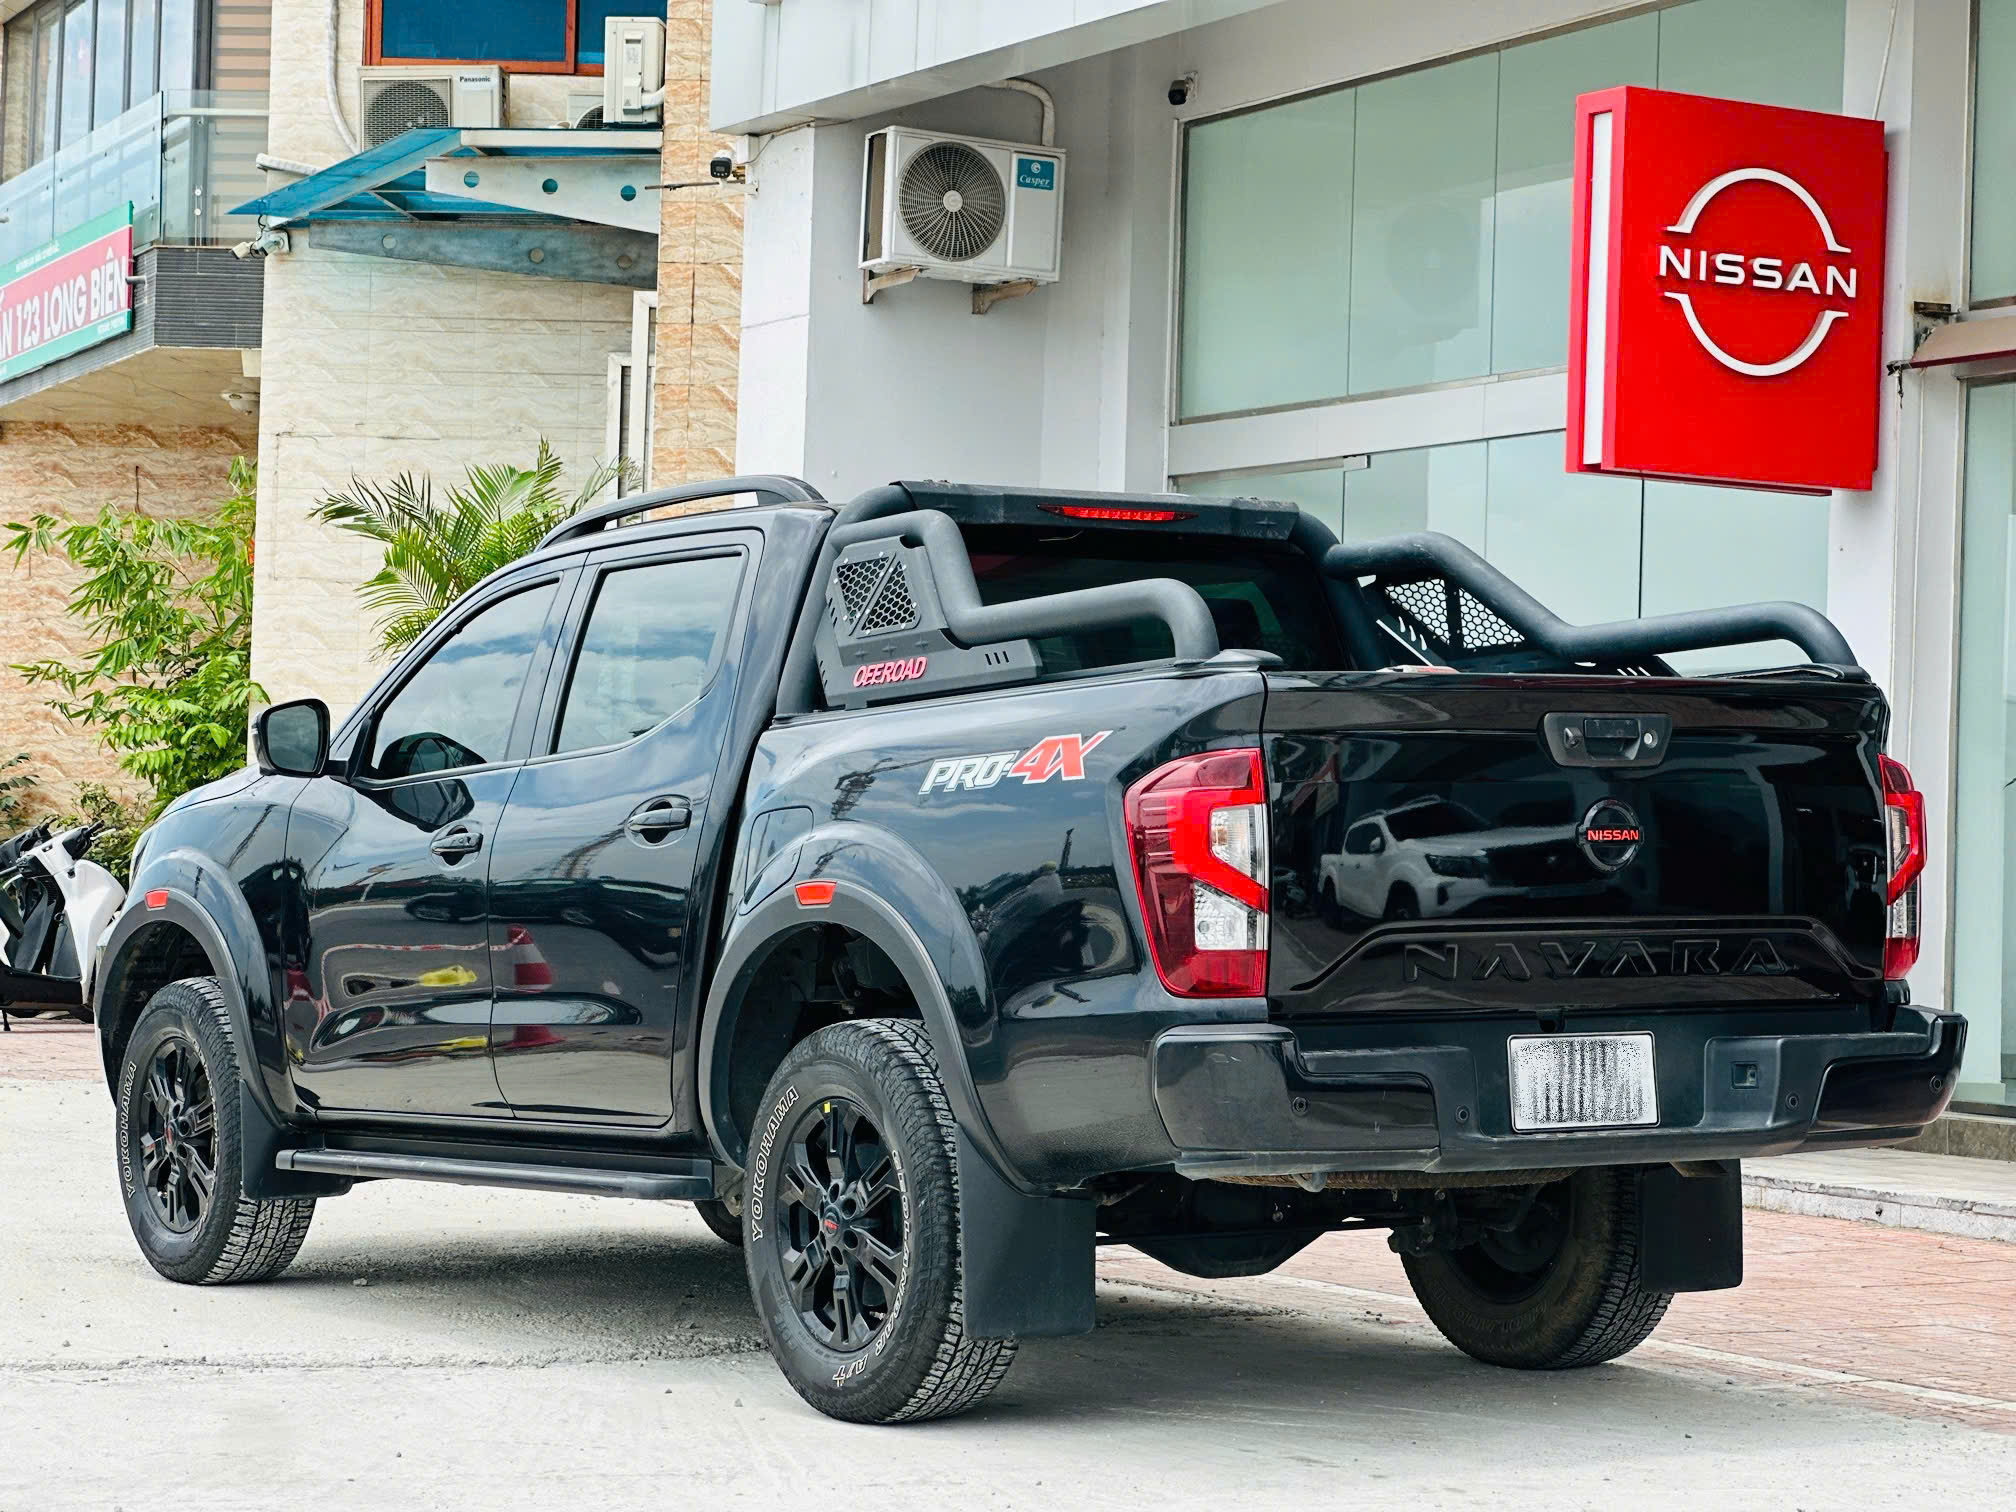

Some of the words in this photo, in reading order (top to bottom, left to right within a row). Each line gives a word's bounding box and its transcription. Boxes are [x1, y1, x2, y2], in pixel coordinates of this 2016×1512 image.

[1019, 174, 1051, 187] Casper
[16, 295, 40, 352] 123
[43, 273, 87, 341] LONG
[90, 246, 127, 321] BIÊN
[1659, 245, 1857, 298] NISSAN
[1587, 829, 1639, 841] NISSAN
[1404, 938, 1788, 982] NAVARA
[120, 1060, 138, 1200] YOKOHAMA
[752, 1085, 800, 1243] YOKOHAMA
[874, 1149, 912, 1357] GEOLANDAR
